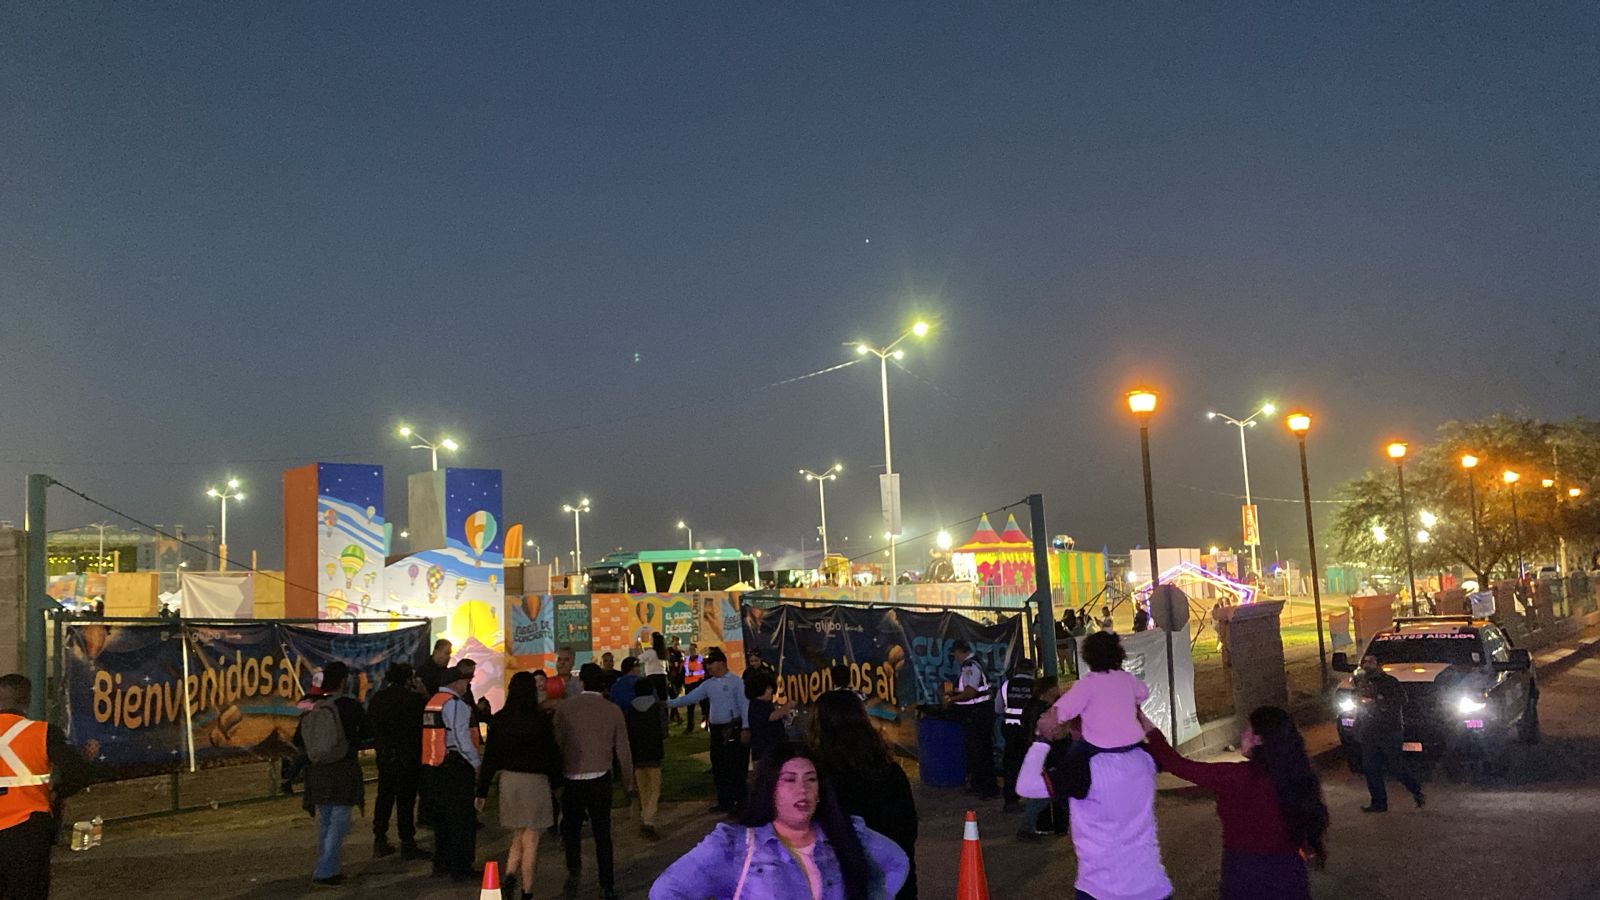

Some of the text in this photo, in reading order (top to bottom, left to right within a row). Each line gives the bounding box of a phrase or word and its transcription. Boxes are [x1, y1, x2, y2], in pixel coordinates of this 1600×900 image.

[93, 650, 303, 730] Bienvenidos al
[876, 665, 897, 705] al
